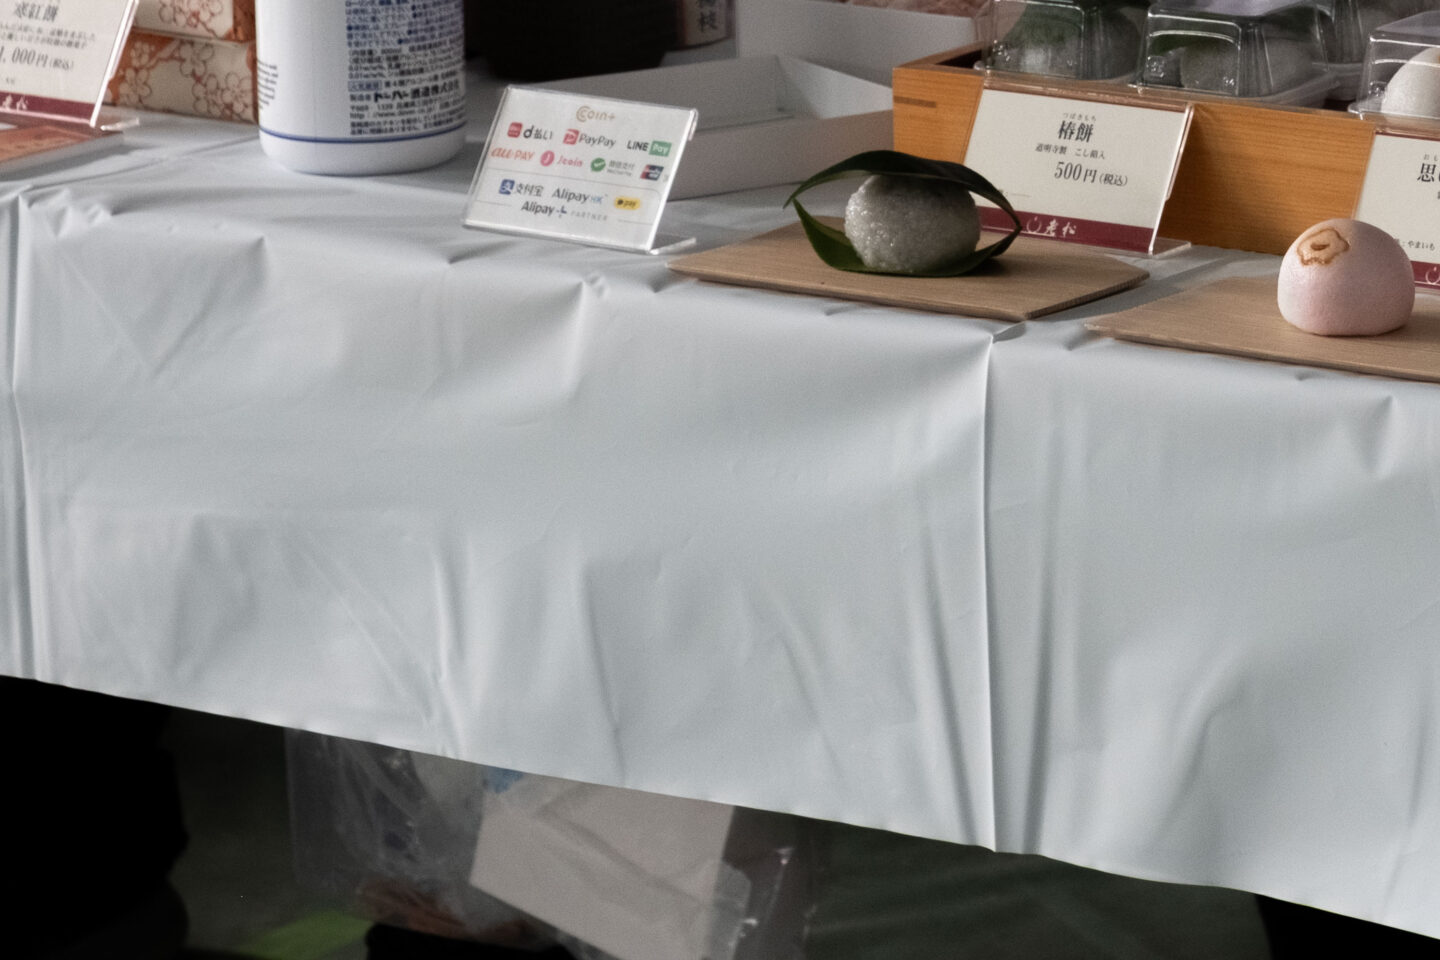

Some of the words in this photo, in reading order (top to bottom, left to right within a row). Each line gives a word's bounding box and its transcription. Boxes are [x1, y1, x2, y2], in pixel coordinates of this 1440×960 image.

[523, 125, 553, 141] d払い
[1057, 120, 1094, 143] 椿餅
[579, 133, 616, 149] PayPay
[627, 140, 649, 152] LINE
[653, 143, 669, 154] Pay
[514, 150, 535, 161] PAY
